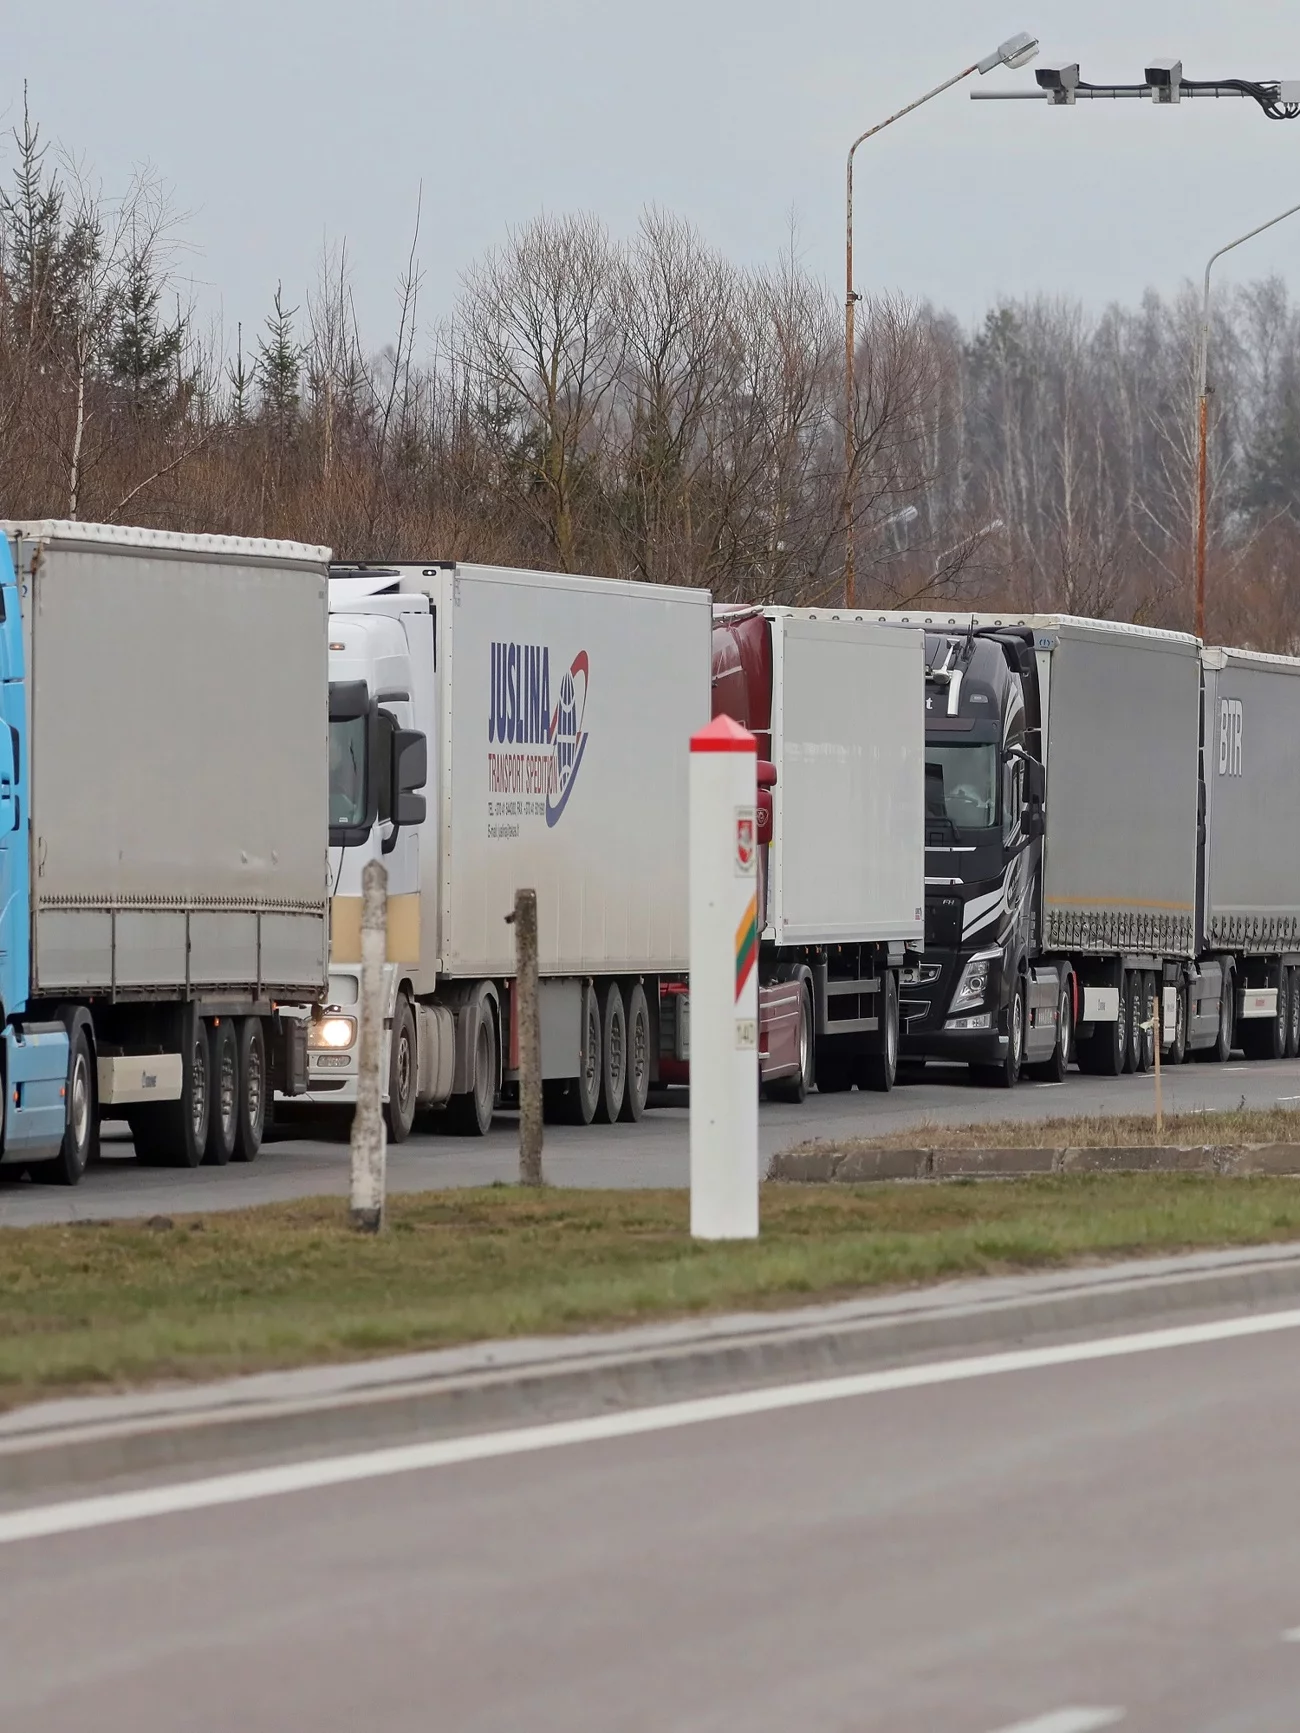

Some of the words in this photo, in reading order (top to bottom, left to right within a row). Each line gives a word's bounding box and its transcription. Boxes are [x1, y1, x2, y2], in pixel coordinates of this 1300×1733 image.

[489, 642, 551, 744] JUSLINA
[488, 753, 525, 793] TRANSPORT
[526, 755, 558, 794] SPEDITION
[1219, 699, 1243, 775] BTR
